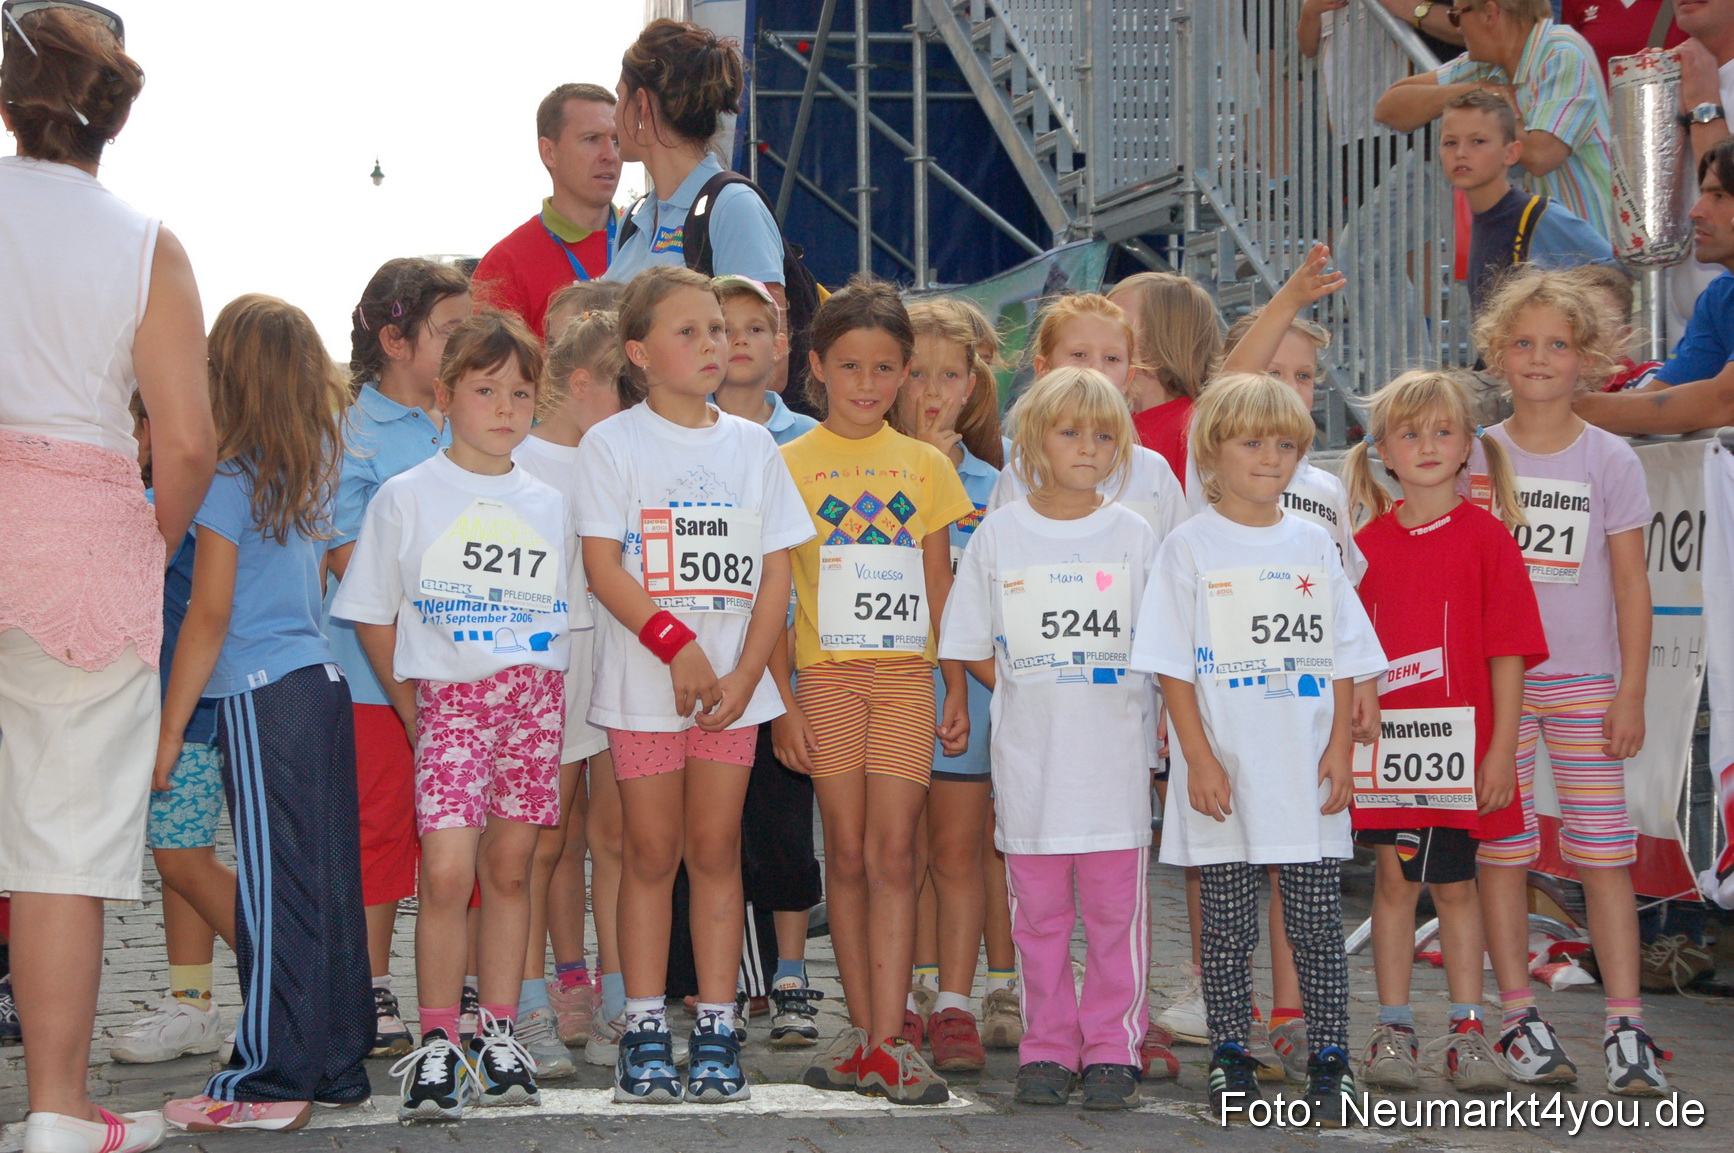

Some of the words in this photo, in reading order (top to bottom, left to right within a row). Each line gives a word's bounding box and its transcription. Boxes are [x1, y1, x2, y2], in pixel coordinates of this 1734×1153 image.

[1281, 491, 1338, 527] Theresa
[674, 517, 729, 537] Sarah
[462, 541, 547, 578] 5217
[679, 551, 754, 587] 5082
[854, 562, 904, 582] Vanessa
[1049, 571, 1084, 584] Maria
[1259, 568, 1291, 581] Laura
[1531, 565, 1578, 577] PFLEIDERER
[424, 598, 523, 615] Neumarkt
[504, 589, 553, 605] PFLEIDERER
[853, 592, 920, 622] 5247
[445, 613, 507, 626] September
[509, 612, 533, 623] 2006
[1041, 609, 1121, 640] 5244
[1251, 613, 1324, 645] 5245
[1086, 651, 1129, 662] PFLEIDERER
[1296, 657, 1334, 667] PFLEIDERER
[1387, 661, 1421, 683] DEHN
[1380, 720, 1453, 739] Marlene
[1382, 752, 1465, 783] 5030
[1427, 794, 1474, 803] PFLEIDERER
